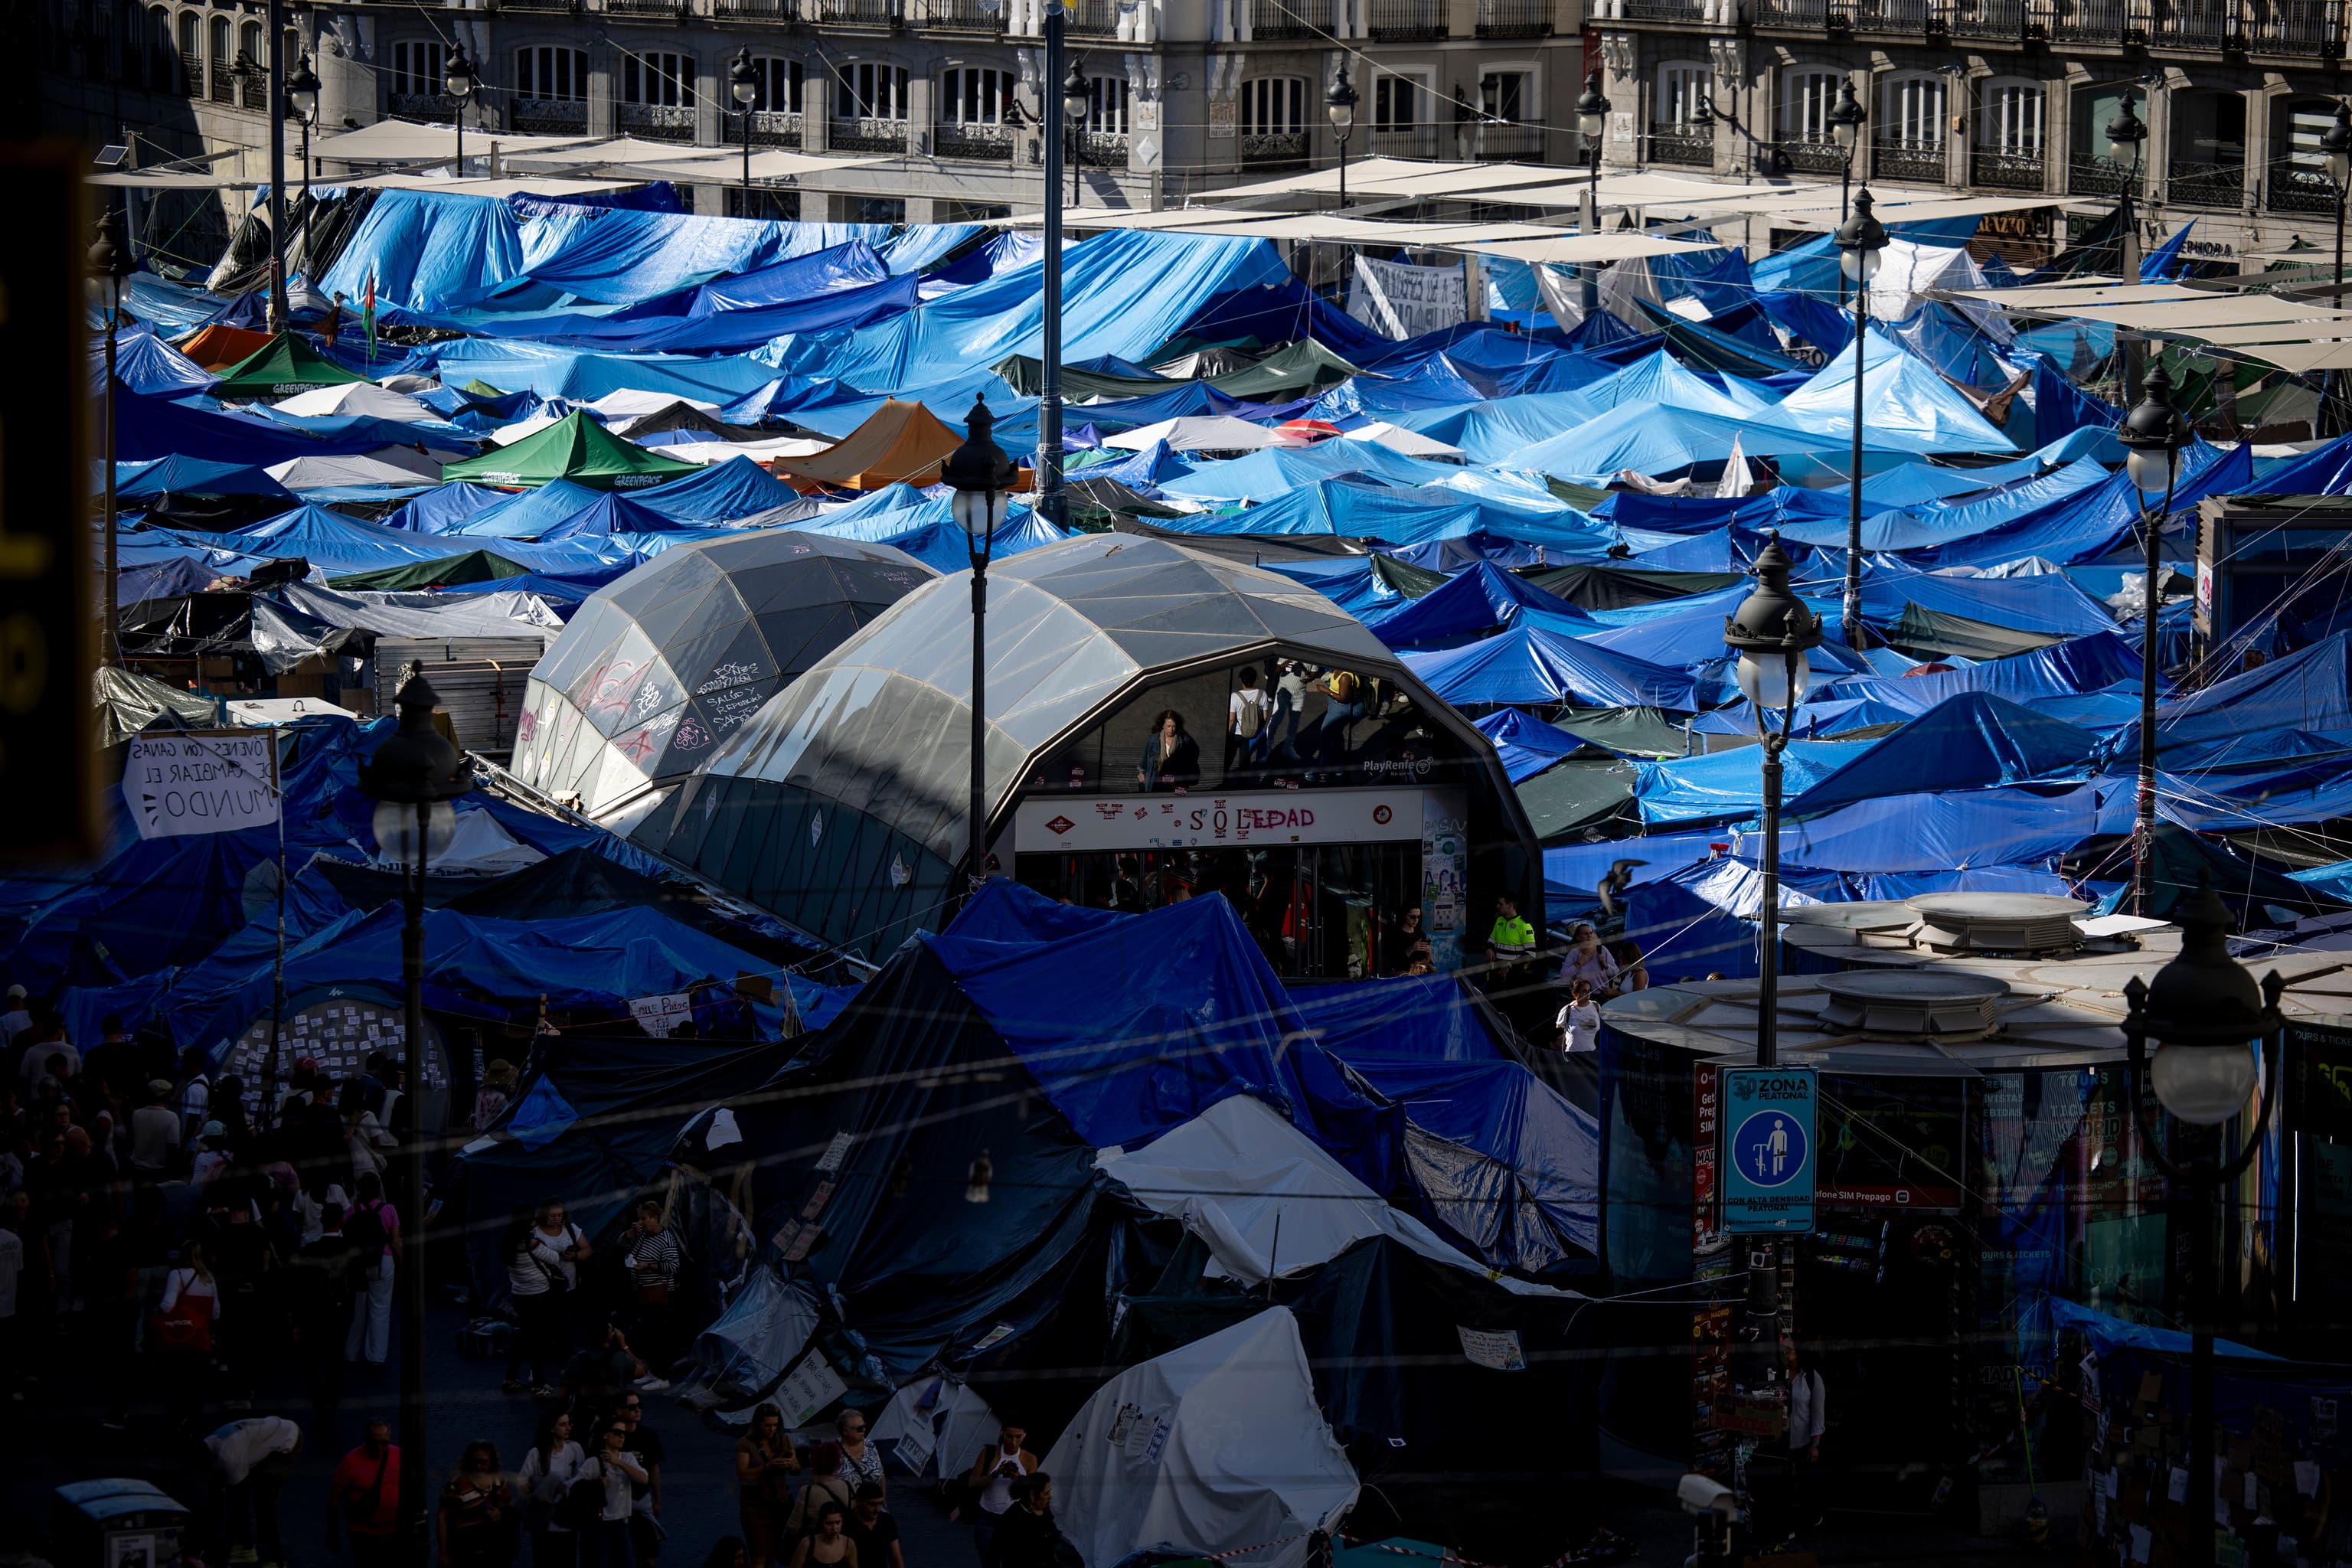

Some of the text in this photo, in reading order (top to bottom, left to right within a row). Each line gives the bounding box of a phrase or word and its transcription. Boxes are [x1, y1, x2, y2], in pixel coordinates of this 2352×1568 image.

[481, 472, 521, 483] GREENPEACE
[614, 475, 663, 487] GREENPEACE
[1363, 760, 1415, 773] PlayRenfe
[1759, 1079, 1808, 1093] ZONA
[1759, 1092, 1809, 1100] PEATONAL
[1769, 1195, 1810, 1204] DENSIDAD
[1838, 1191, 1856, 1200] SIM
[1857, 1192, 1891, 1202] Prepago
[1748, 1204, 1790, 1212] PEATONAL
